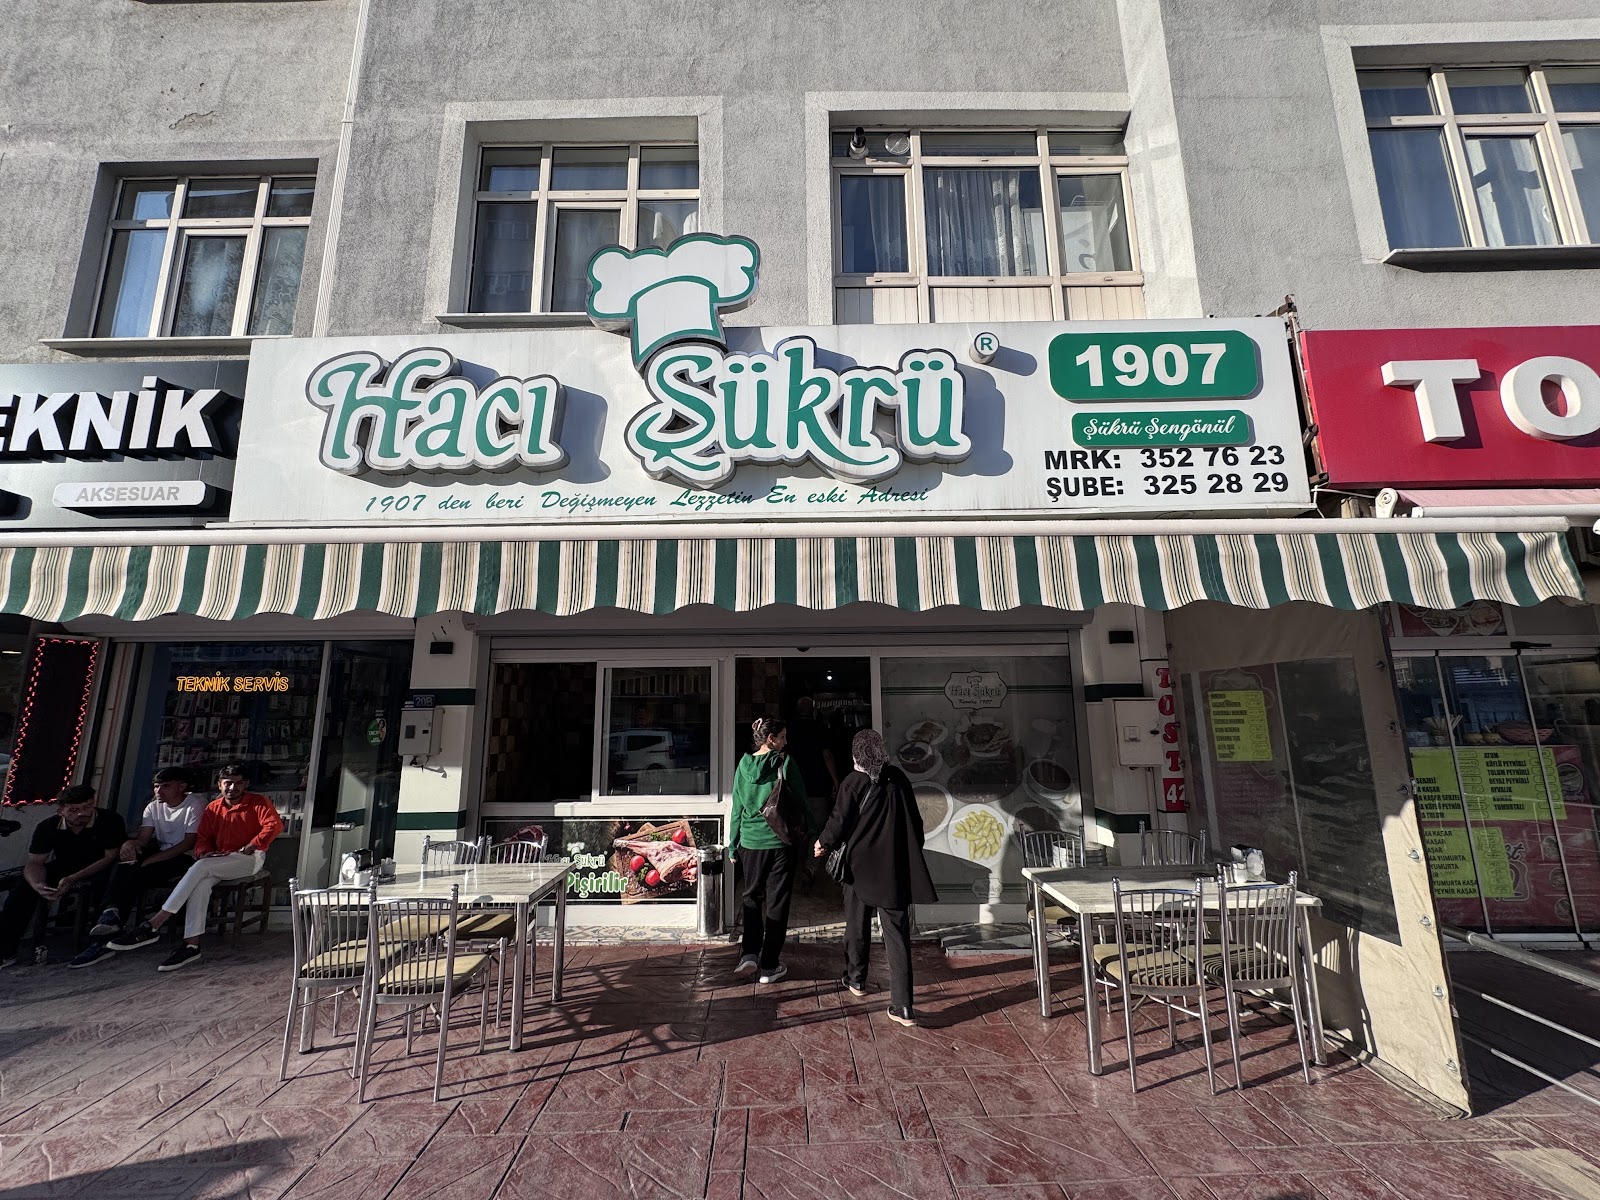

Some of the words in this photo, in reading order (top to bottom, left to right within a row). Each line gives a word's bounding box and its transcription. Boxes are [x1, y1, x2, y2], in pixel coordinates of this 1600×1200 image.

[1075, 343, 1227, 387] 1907
[312, 353, 556, 468] Hacı
[629, 341, 967, 478] Şükrü
[1083, 418, 1142, 440] Şükrü
[1146, 415, 1236, 441] Şengönül
[1044, 449, 1121, 470] MRK:
[1140, 447, 1194, 468] 352
[1203, 446, 1239, 467] 76
[1248, 445, 1285, 466] 23
[75, 486, 180, 502] AKSESUAR
[365, 494, 427, 512] 1907
[438, 495, 472, 510] den
[485, 493, 524, 509] beri
[541, 490, 658, 513] Değişmeyen
[671, 488, 754, 511] Lezzetin
[766, 485, 797, 503] En
[807, 487, 848, 503] eski
[857, 486, 928, 504] Adresi
[1046, 475, 1124, 502] ŞUBE:
[1143, 474, 1197, 495] 325
[1206, 473, 1243, 494] 28
[1252, 472, 1289, 493] 29
[176, 671, 230, 692] TEKNİK
[233, 671, 289, 692] SERVİS
[415, 697, 433, 707] 20B
